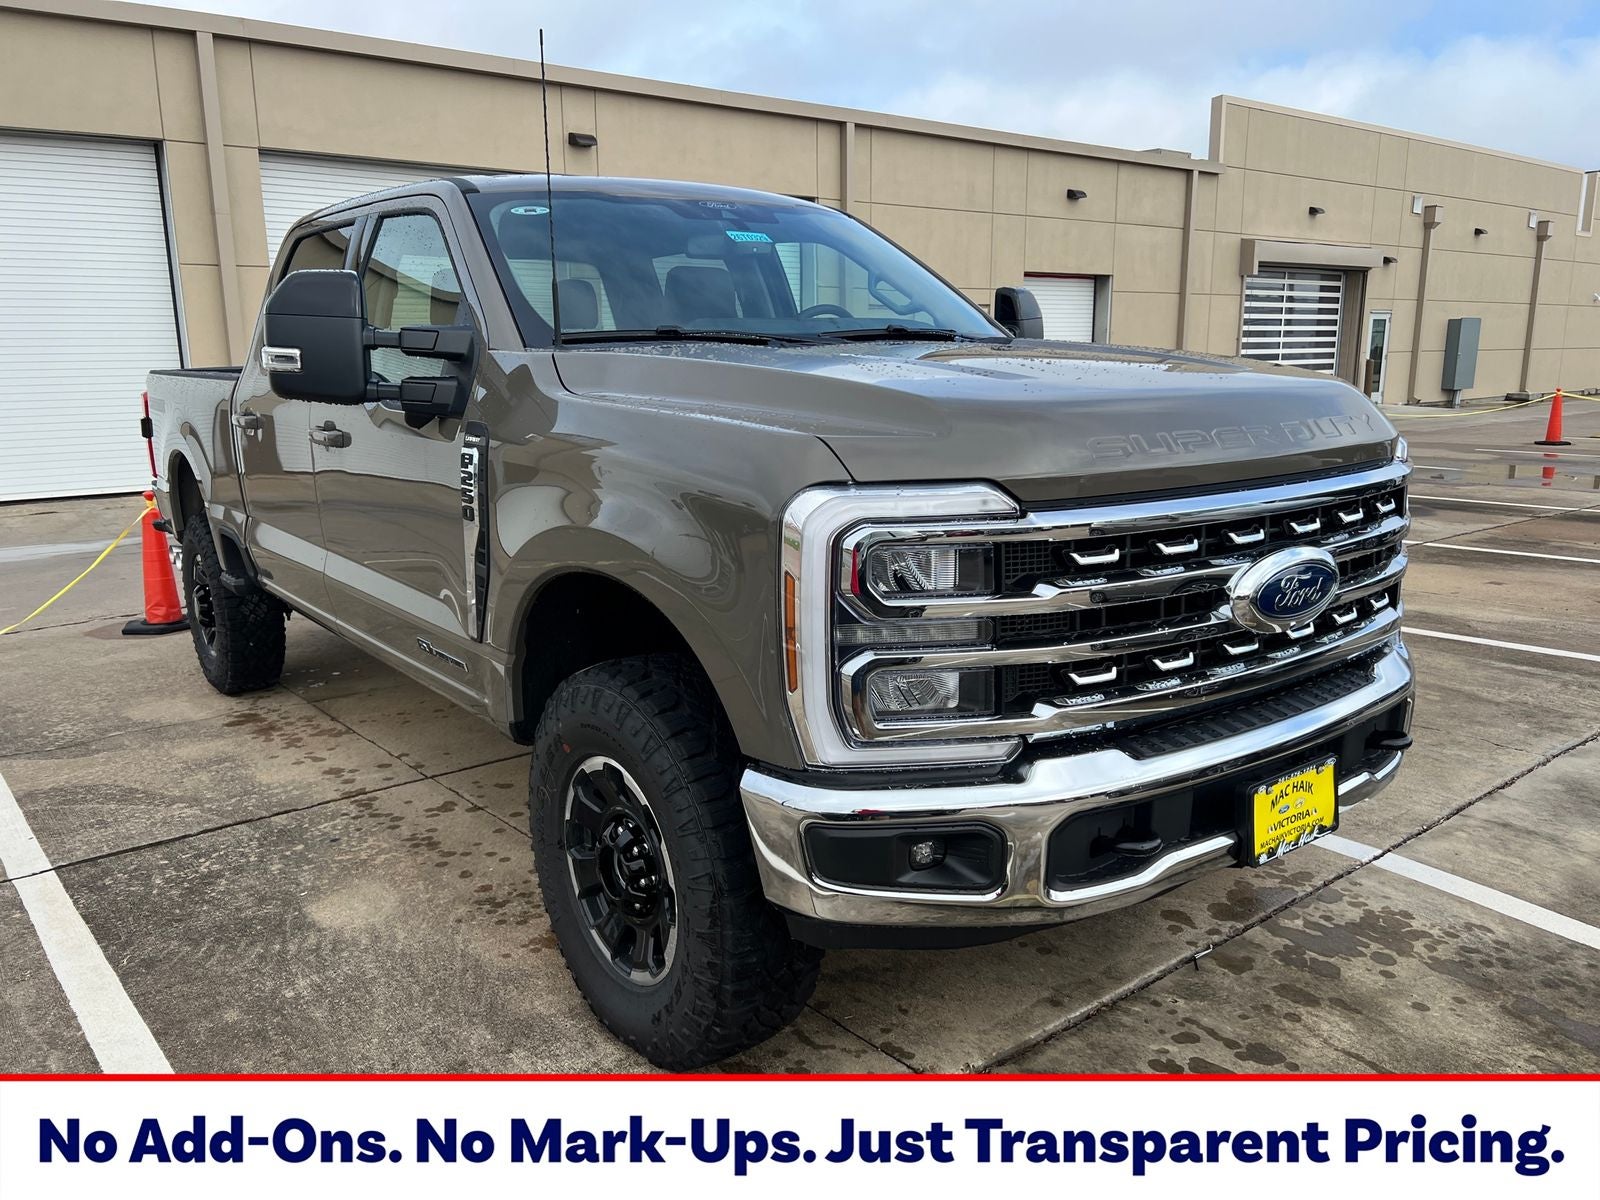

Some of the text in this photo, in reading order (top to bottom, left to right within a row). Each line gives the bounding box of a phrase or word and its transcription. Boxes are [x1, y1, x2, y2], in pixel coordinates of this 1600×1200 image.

[1086, 414, 1374, 461] SUPER DUTY
[1275, 572, 1323, 611] Ford
[1270, 785, 1290, 812] MAC
[1292, 780, 1314, 795] HAIK
[1272, 809, 1311, 831] VICTORIA
